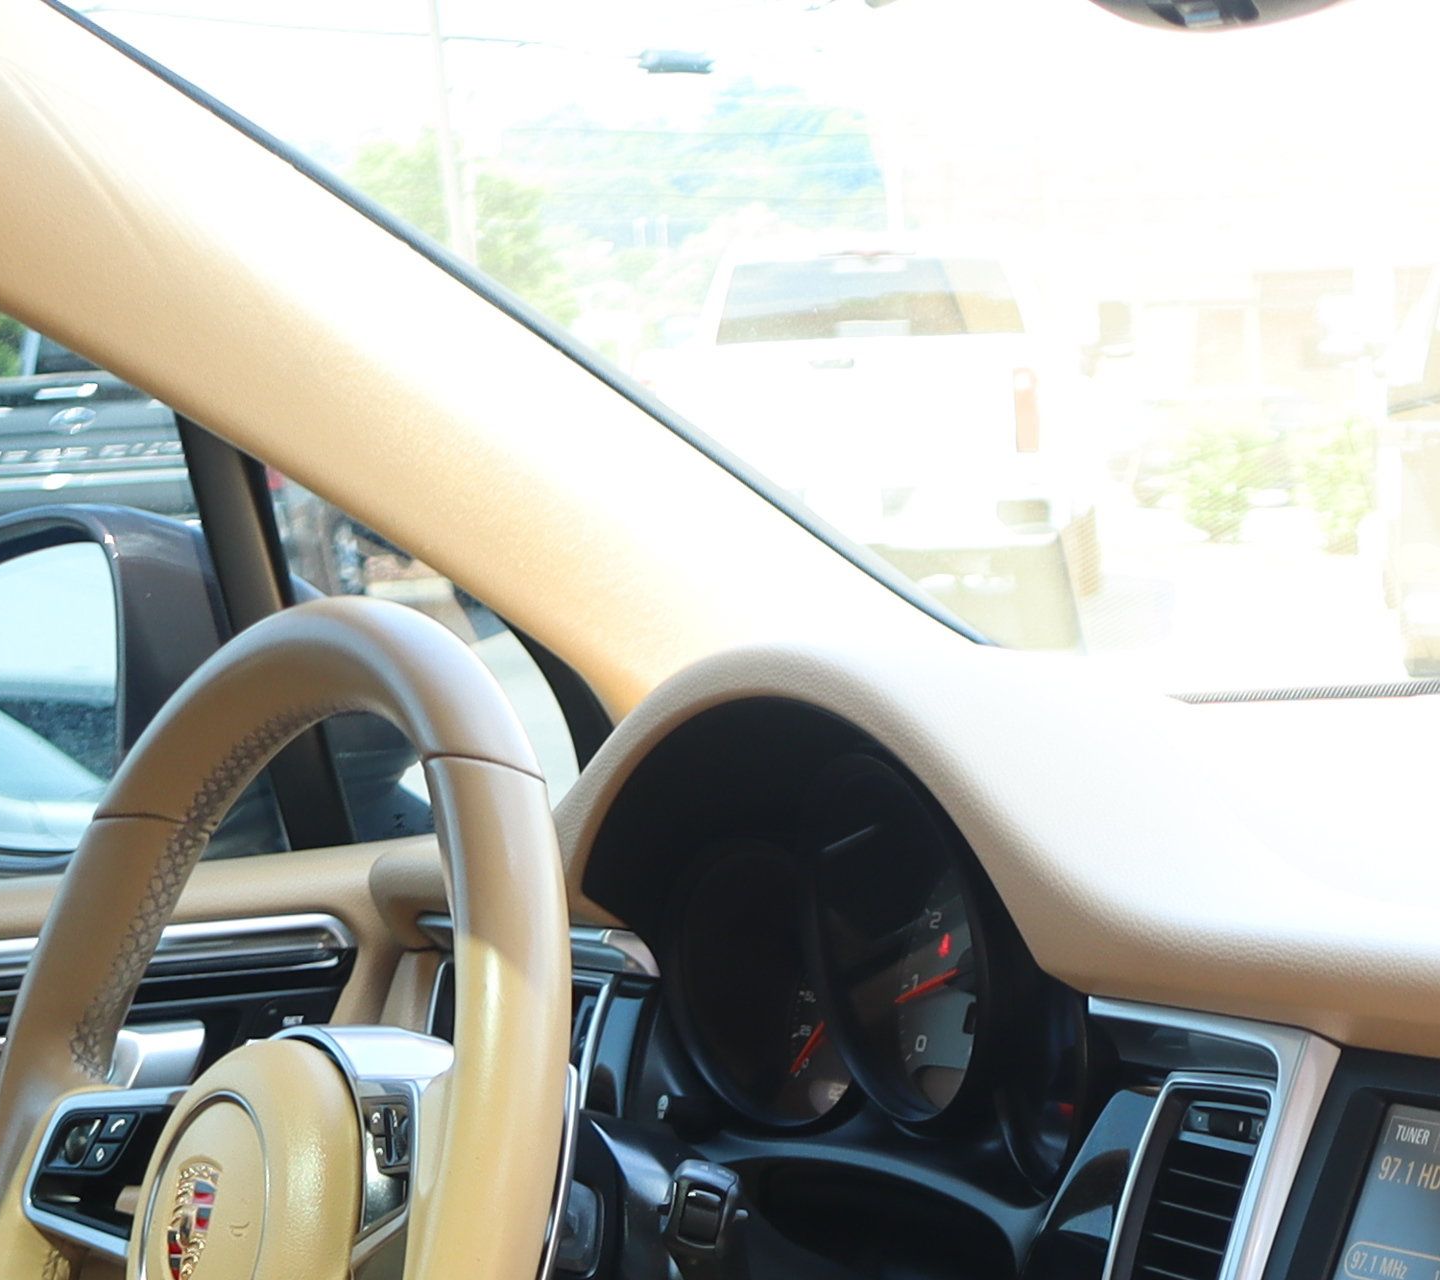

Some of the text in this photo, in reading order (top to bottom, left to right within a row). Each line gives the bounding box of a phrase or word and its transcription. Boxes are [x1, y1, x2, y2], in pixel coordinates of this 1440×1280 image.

[929, 911, 942, 929] 2
[915, 1034, 927, 1052] 0
[1395, 1124, 1431, 1146] TUNER
[1378, 1156, 1415, 1184] 97.1
[1350, 1251, 1408, 1280] 97.1 MHz
